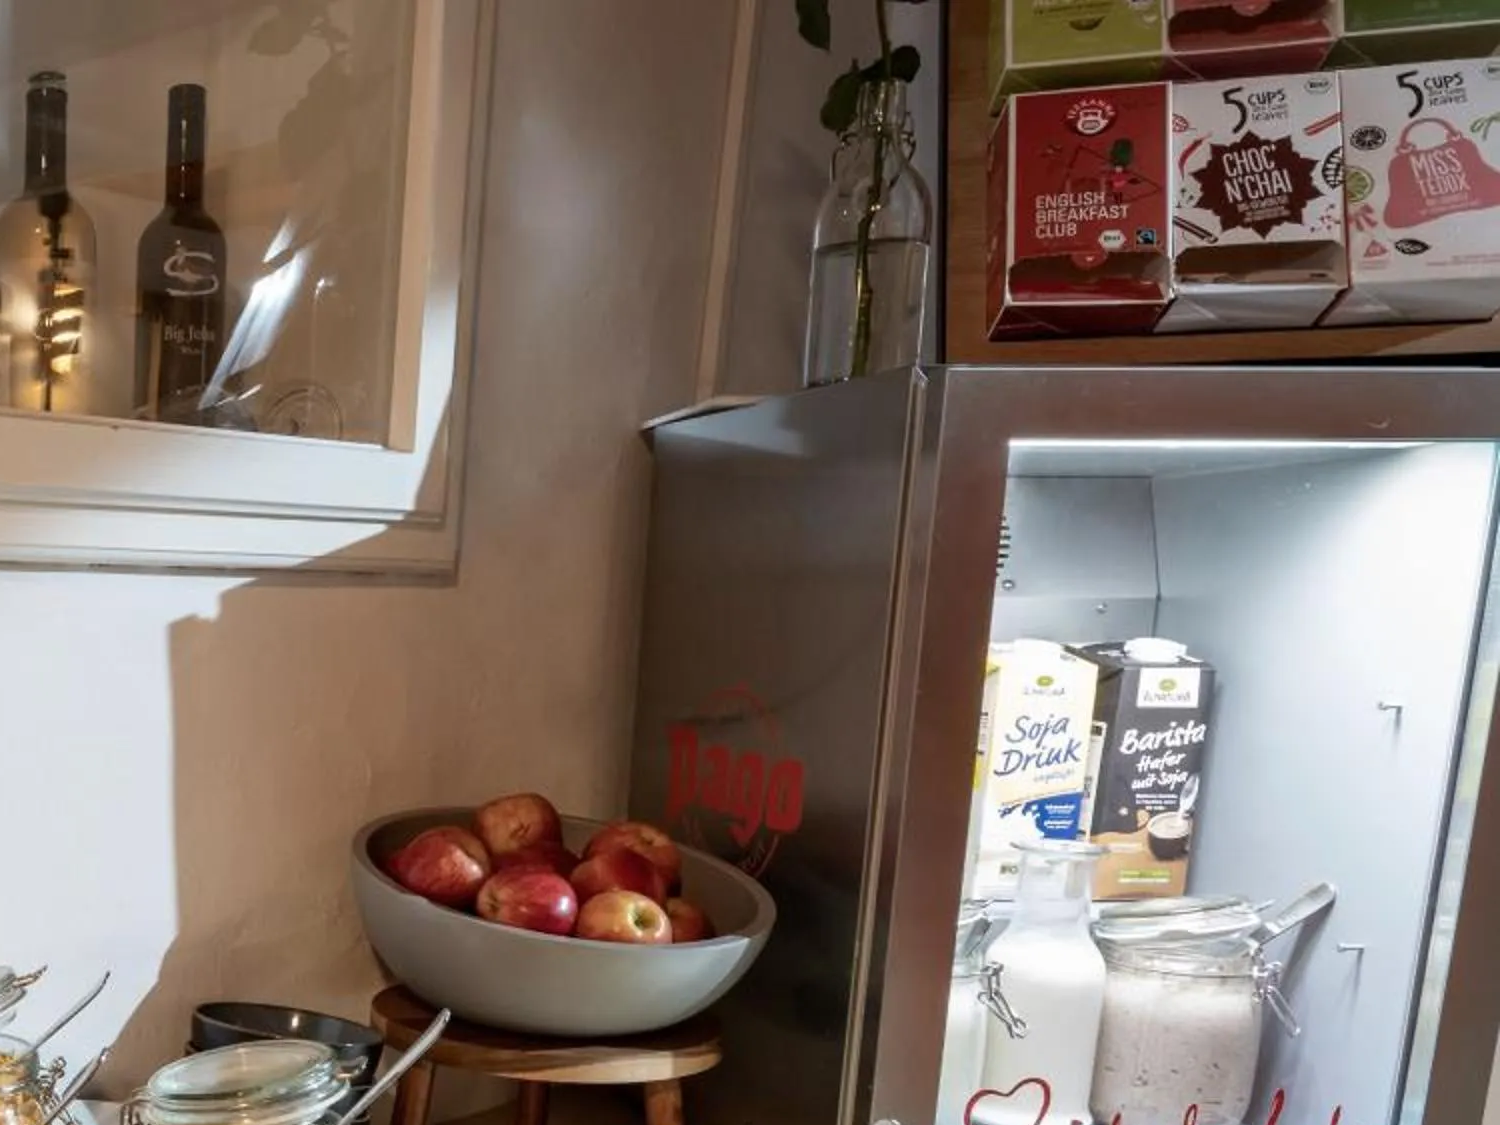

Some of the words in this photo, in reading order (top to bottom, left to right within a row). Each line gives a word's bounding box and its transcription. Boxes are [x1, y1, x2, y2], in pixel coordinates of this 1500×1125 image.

[1396, 70, 1423, 118] 5
[1424, 71, 1464, 89] CUPS
[1222, 86, 1247, 134] 5
[1248, 88, 1286, 106] CUPS
[1409, 147, 1464, 178] MISS
[1035, 191, 1105, 209] ENGLISH
[1035, 204, 1130, 224] BREAKFAST
[1035, 222, 1077, 239] CLUB
[1005, 714, 1070, 748] Soja
[1119, 719, 1207, 755] Barista
[1158, 770, 1188, 791] Soja
